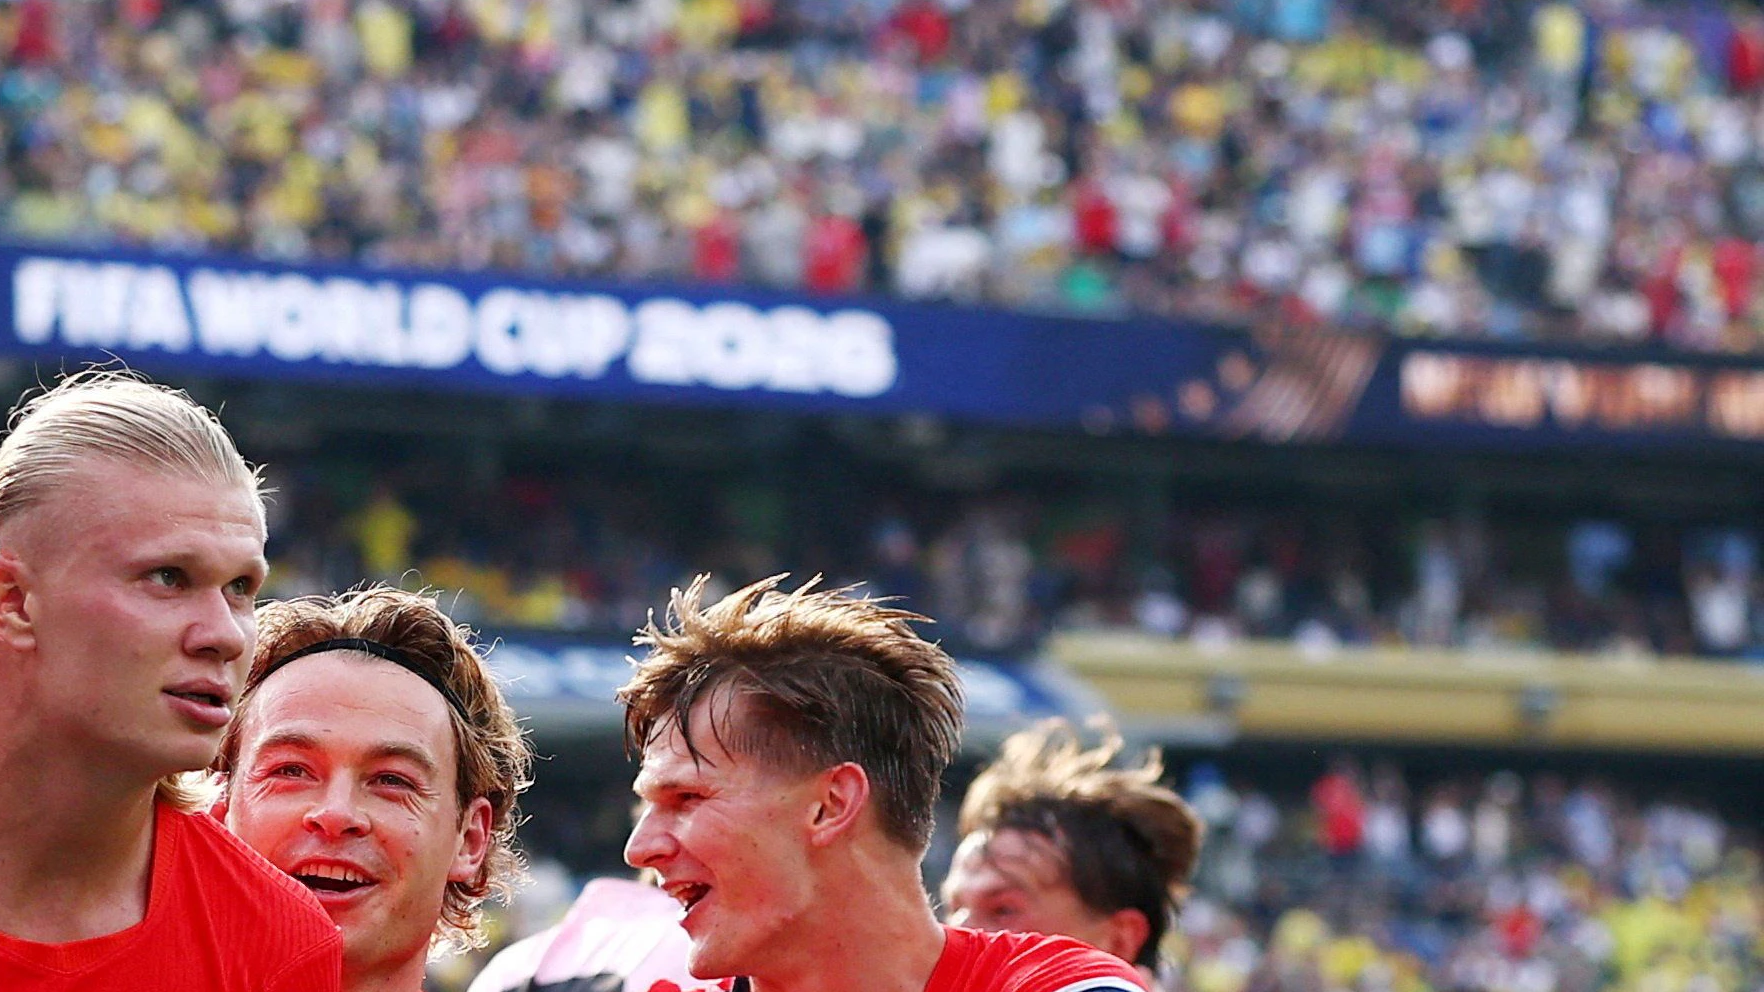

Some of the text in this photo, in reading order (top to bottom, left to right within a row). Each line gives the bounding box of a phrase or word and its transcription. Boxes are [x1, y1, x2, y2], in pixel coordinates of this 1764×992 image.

[12, 255, 897, 397] FIFA WORLD CUP 2026
